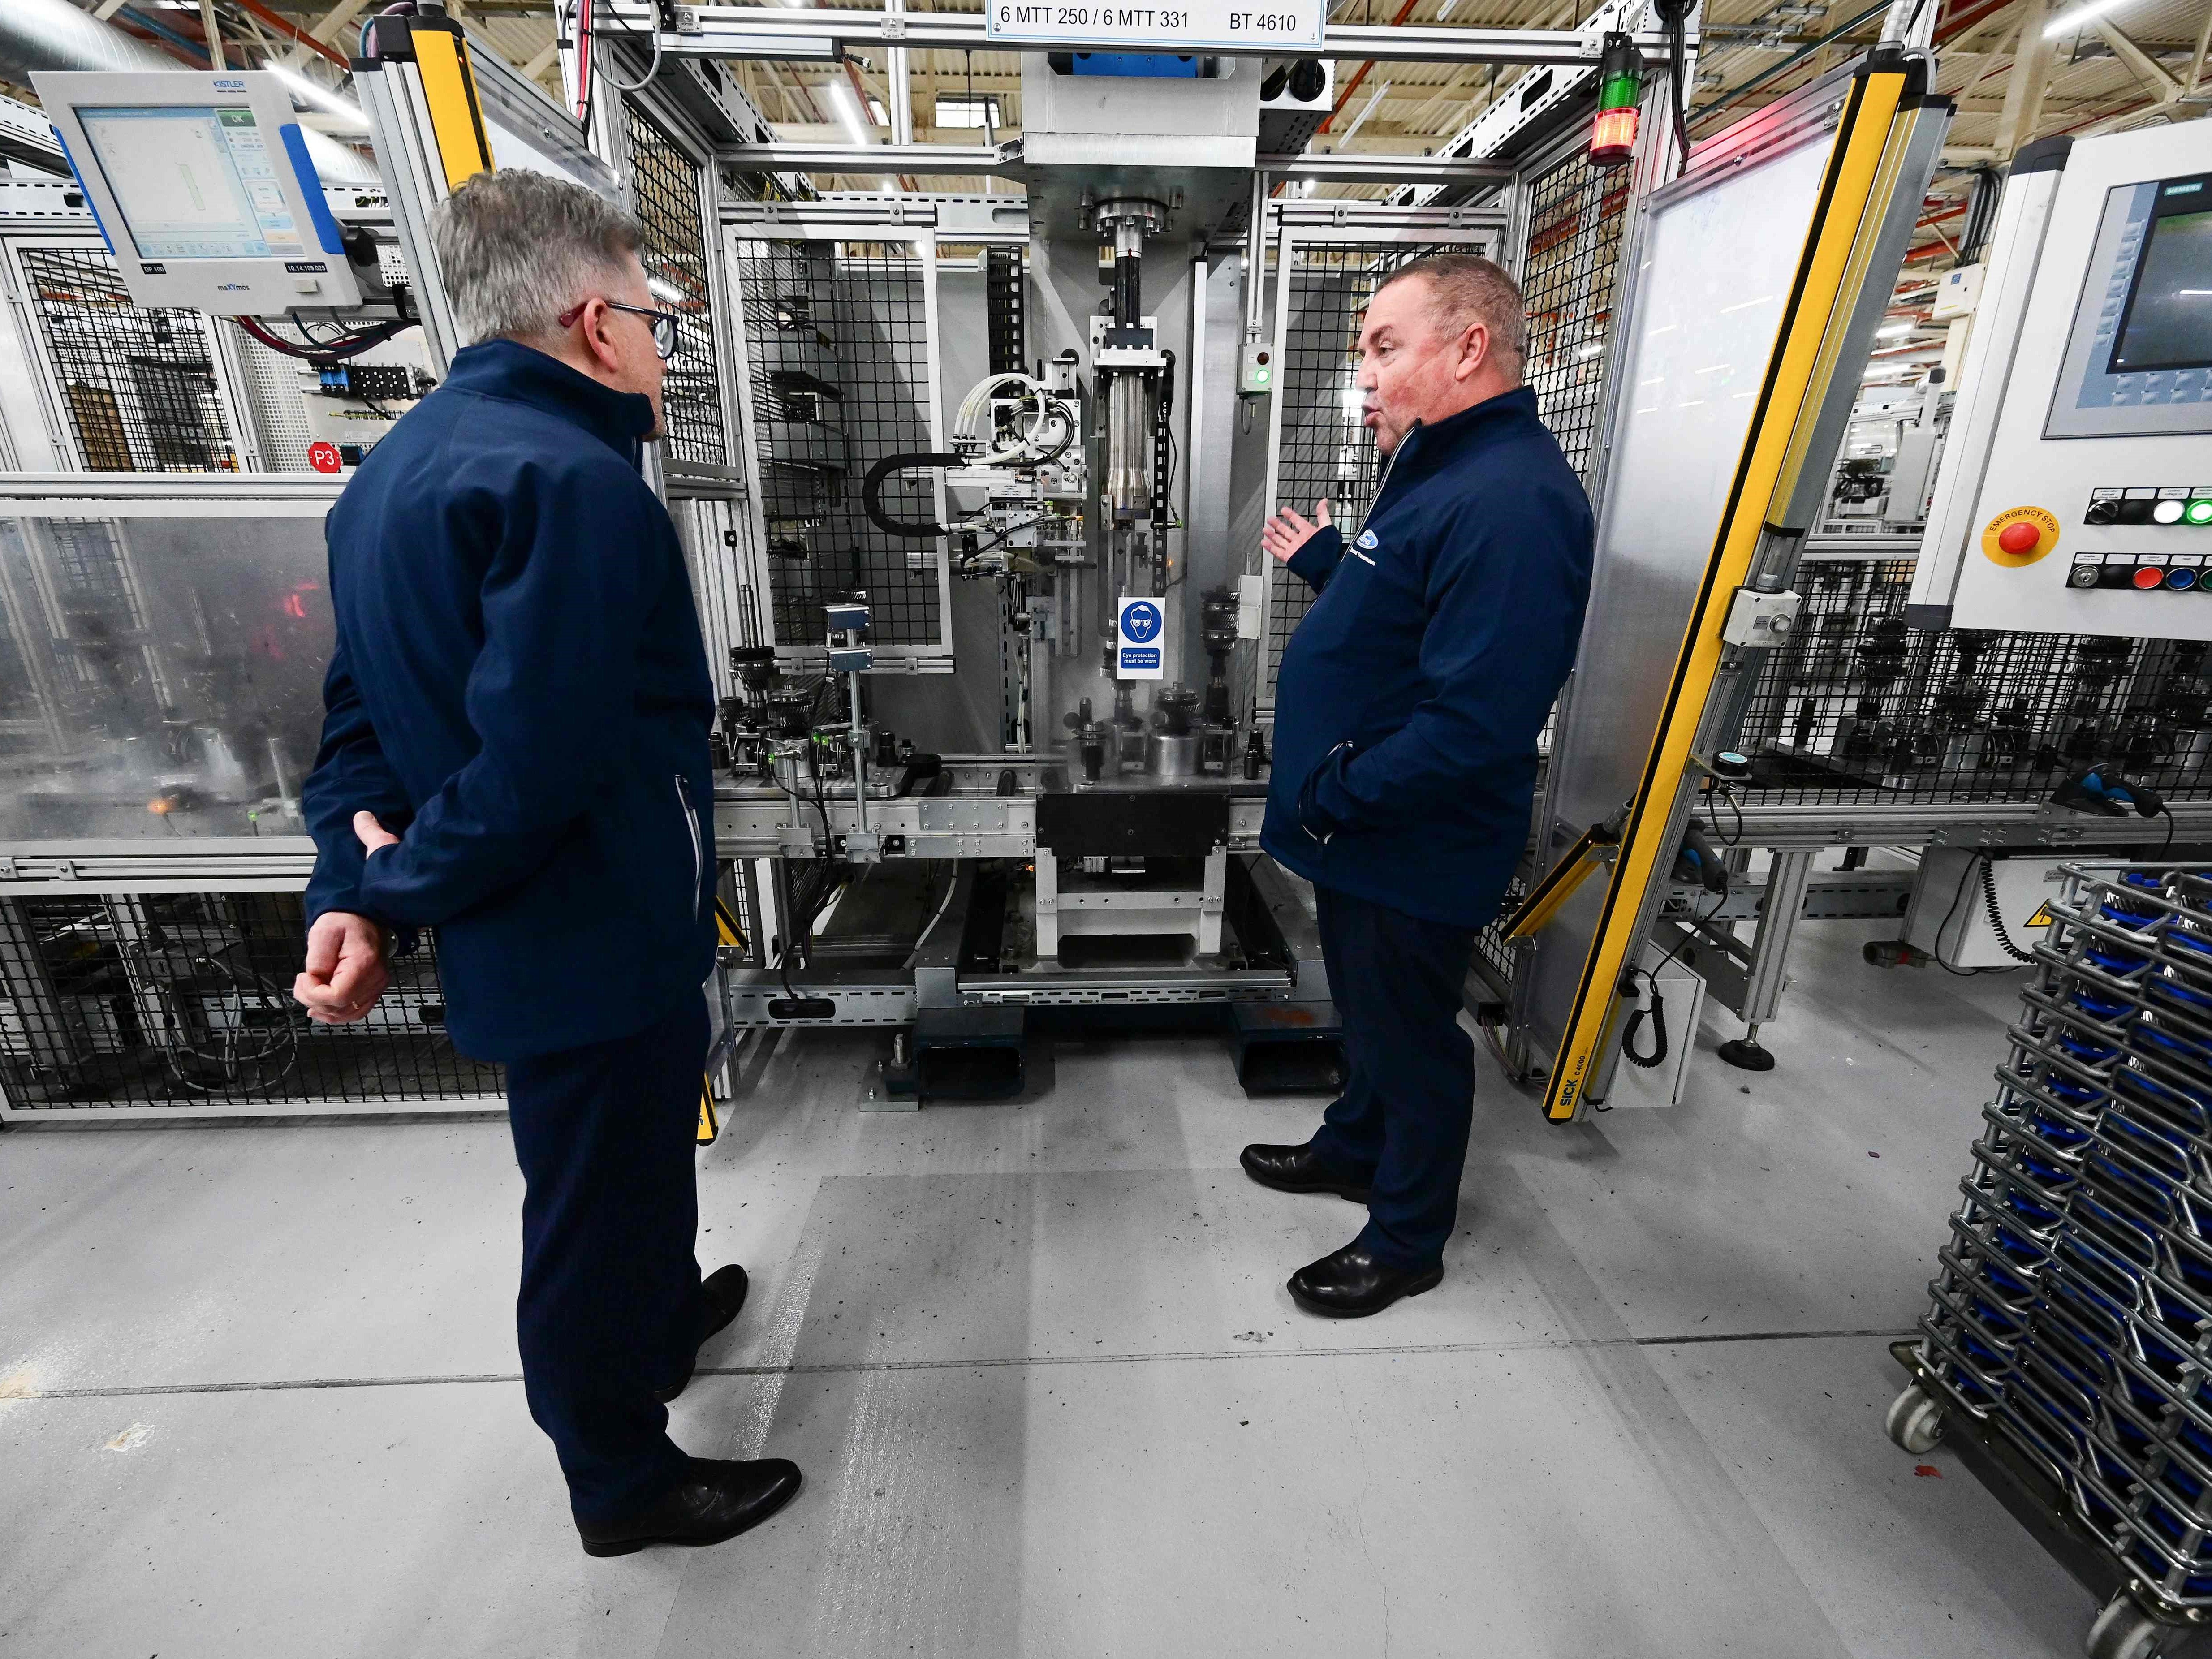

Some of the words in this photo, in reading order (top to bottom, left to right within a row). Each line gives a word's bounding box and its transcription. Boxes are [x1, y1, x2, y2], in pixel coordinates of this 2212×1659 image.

[1000, 6, 1010, 22] 6
[1017, 6, 1053, 23] MTT
[1058, 8, 1088, 25] 250
[1093, 9, 1098, 25] /
[1103, 9, 1112, 26] 6
[1119, 10, 1155, 26] MTT
[1160, 11, 1187, 28] 331
[1230, 13, 1252, 30] BT
[1257, 14, 1296, 31] 4610
[314, 450, 335, 465] P3
[1990, 509, 2043, 531] EMERGENCY
[2041, 515, 2056, 533] STOP
[1560, 1079, 1578, 1106] SICK
